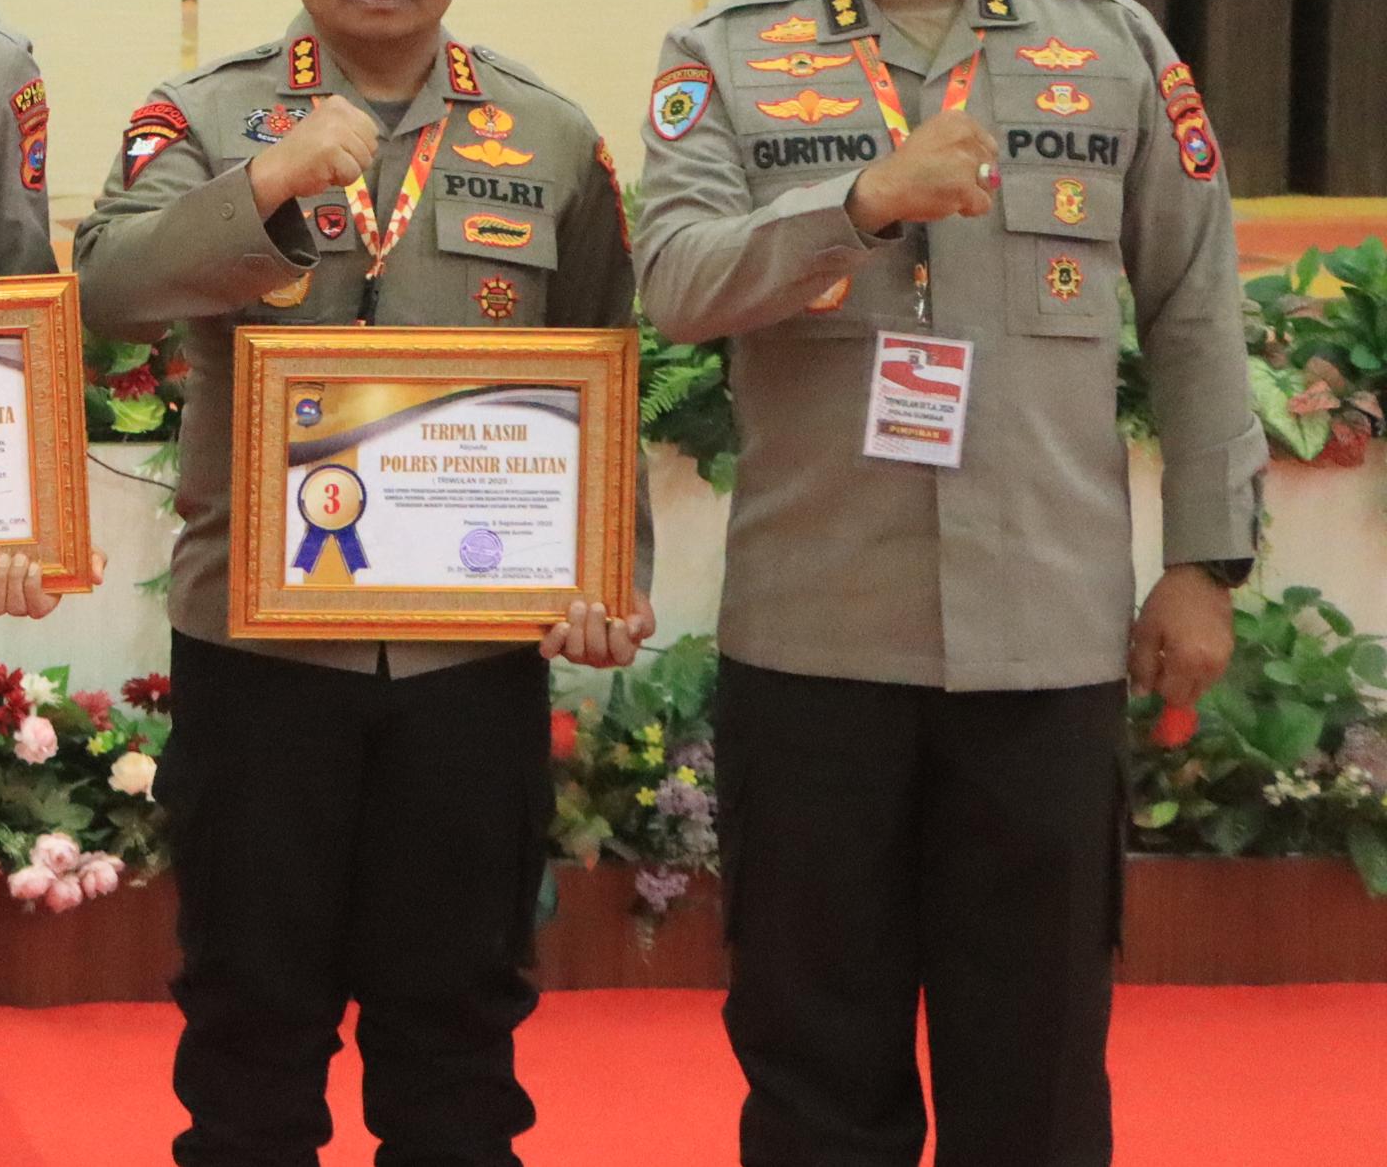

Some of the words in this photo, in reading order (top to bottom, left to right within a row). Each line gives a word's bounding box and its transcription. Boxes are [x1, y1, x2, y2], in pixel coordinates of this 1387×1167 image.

[753, 133, 877, 170] GURITNO
[1008, 128, 1119, 166] POLRI
[444, 173, 545, 210] POLRI
[420, 423, 476, 441] TERIMA
[482, 424, 527, 442] KASIH
[380, 455, 437, 473] POLRES
[442, 456, 500, 474] PESISIR
[505, 456, 567, 475] SELATAN
[323, 483, 341, 515] 3
